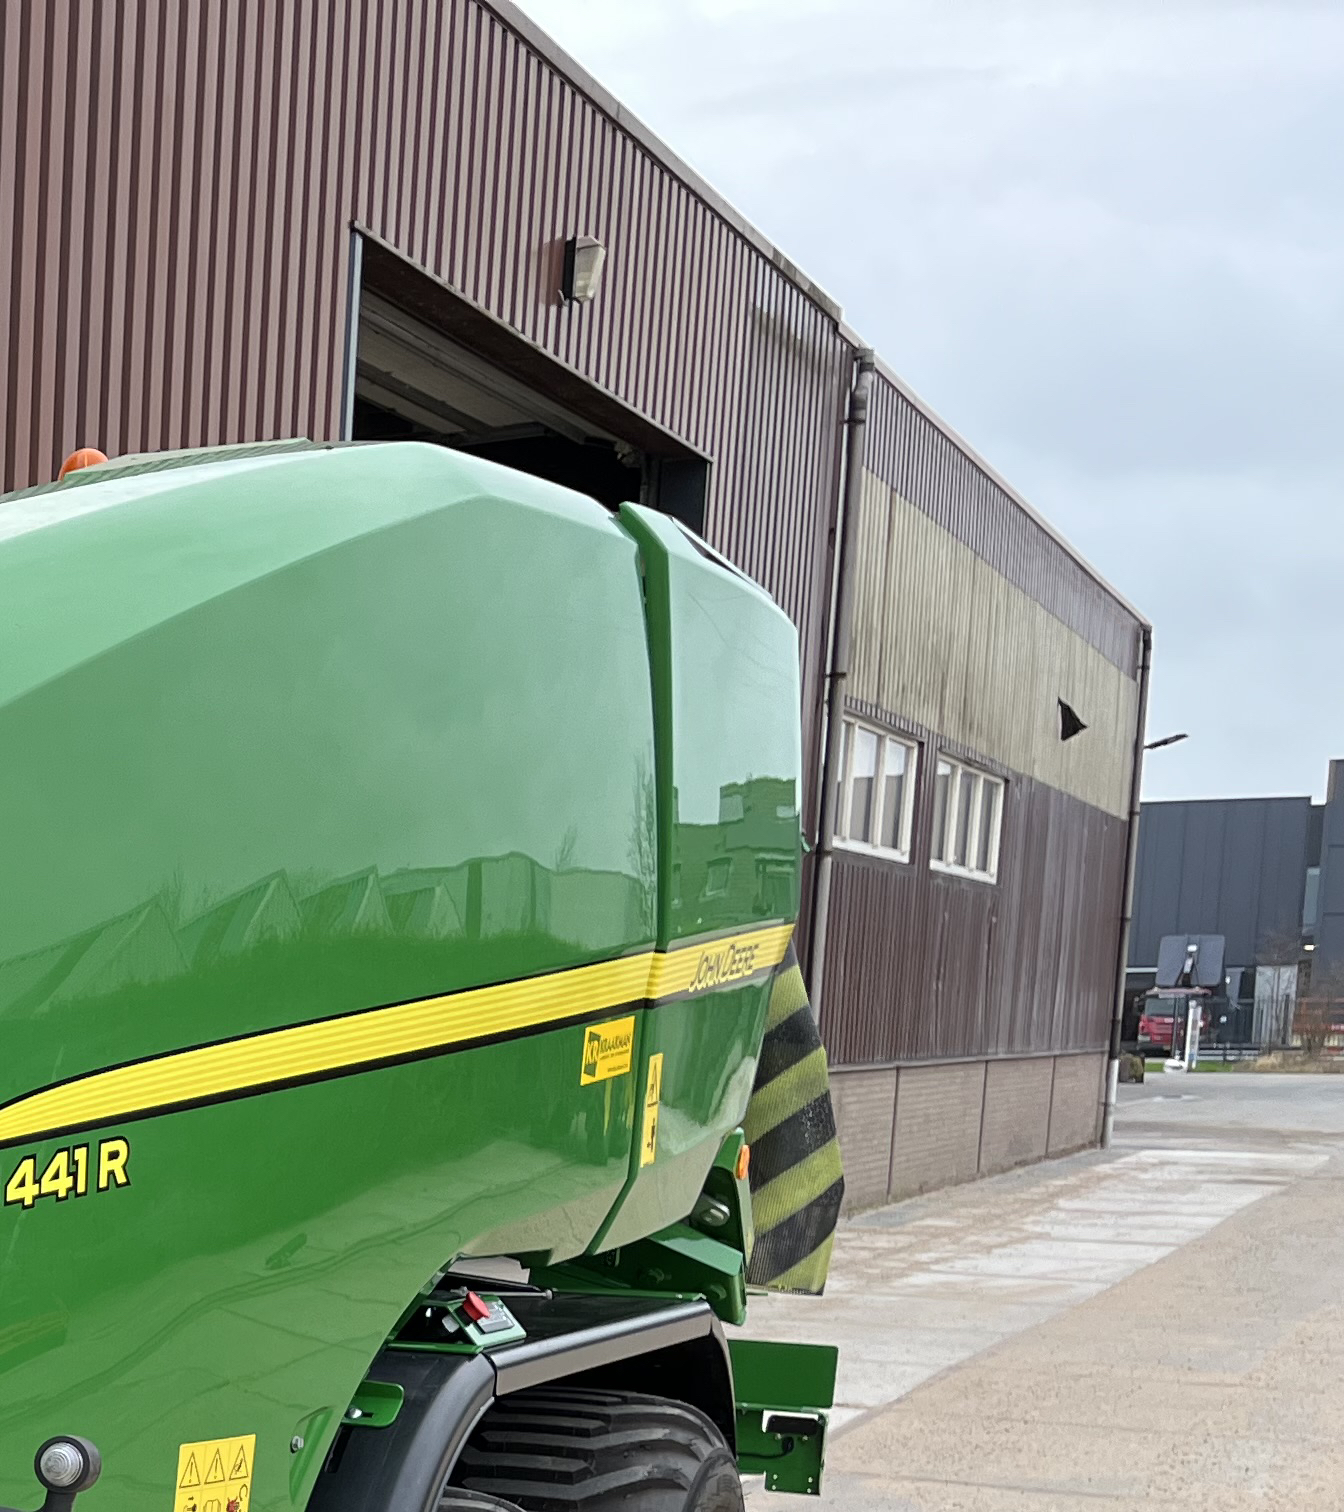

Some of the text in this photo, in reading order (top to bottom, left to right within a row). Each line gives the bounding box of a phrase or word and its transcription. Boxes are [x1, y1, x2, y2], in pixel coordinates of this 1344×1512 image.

[689, 943, 760, 989] JOHN DEERE
[4, 1142, 89, 1210] 441
[97, 1136, 131, 1192] R
